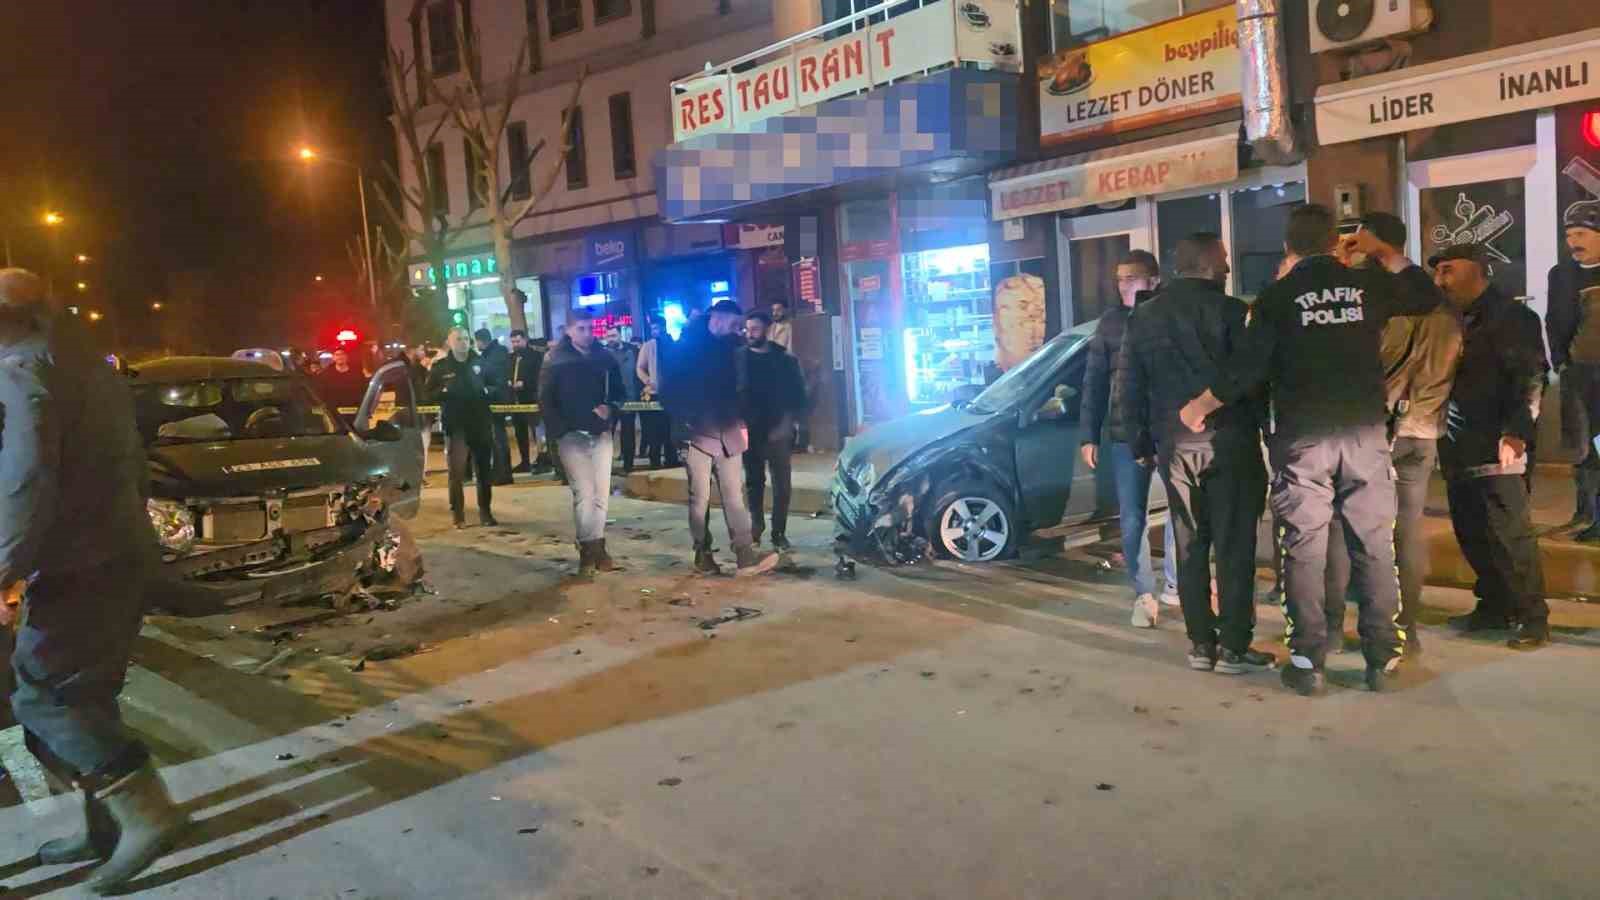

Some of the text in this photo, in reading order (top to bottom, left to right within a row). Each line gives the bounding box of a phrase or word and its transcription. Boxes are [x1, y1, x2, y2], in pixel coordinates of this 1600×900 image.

[1066, 72, 1215, 123] LEZZET DÖNER
[1370, 62, 1589, 124] LİDER İNANLI
[1098, 161, 1169, 193] KEBAP
[594, 240, 624, 255] beko
